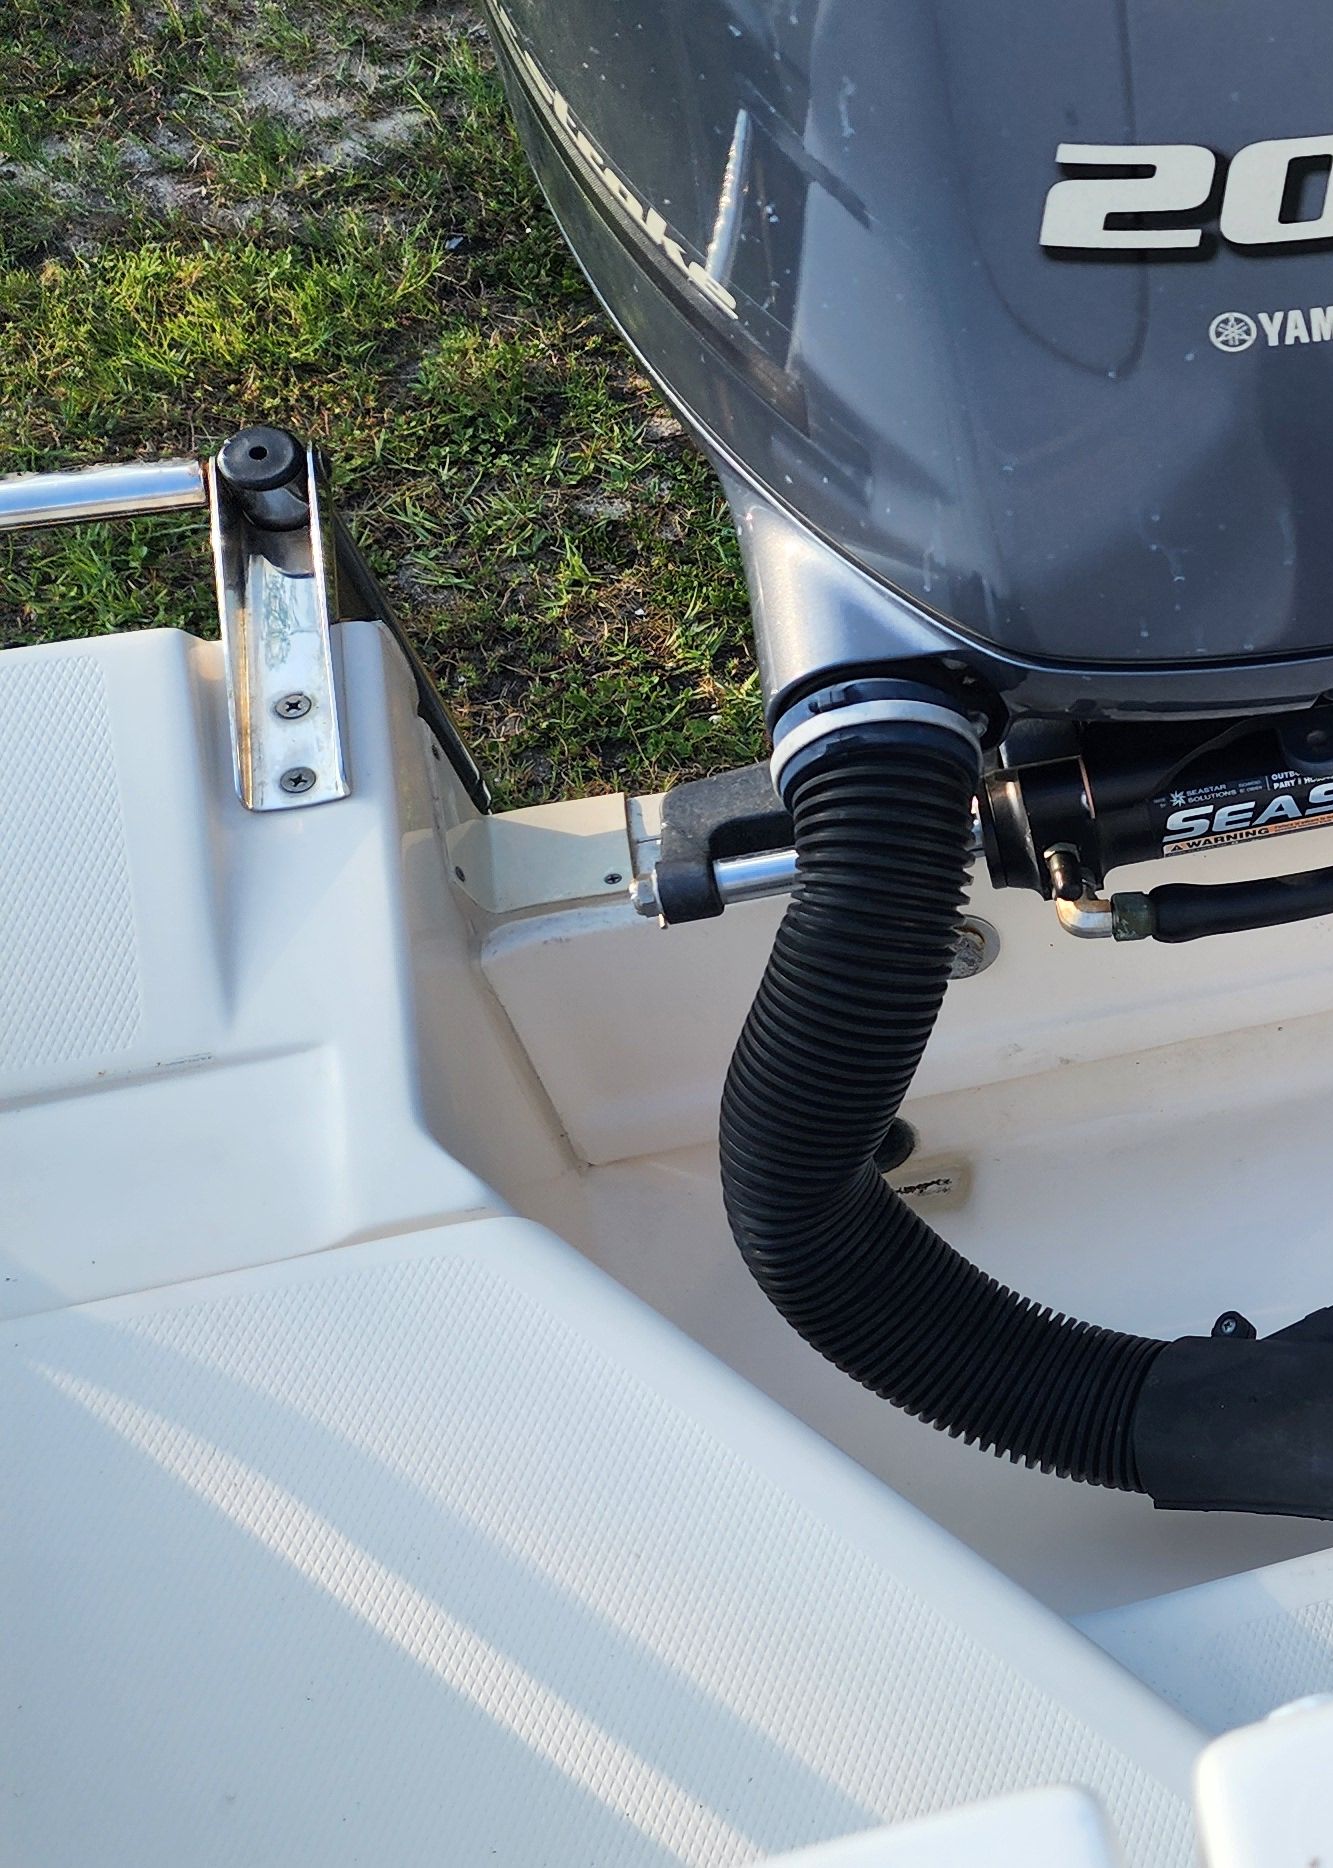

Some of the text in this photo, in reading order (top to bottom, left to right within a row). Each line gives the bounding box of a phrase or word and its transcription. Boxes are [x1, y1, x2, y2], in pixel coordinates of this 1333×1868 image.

[1186, 784, 1227, 797] SEASTAR
[1273, 779, 1296, 790] PART
[1187, 789, 1238, 804] SOLUTIONS
[1187, 828, 1270, 848] WARNING
